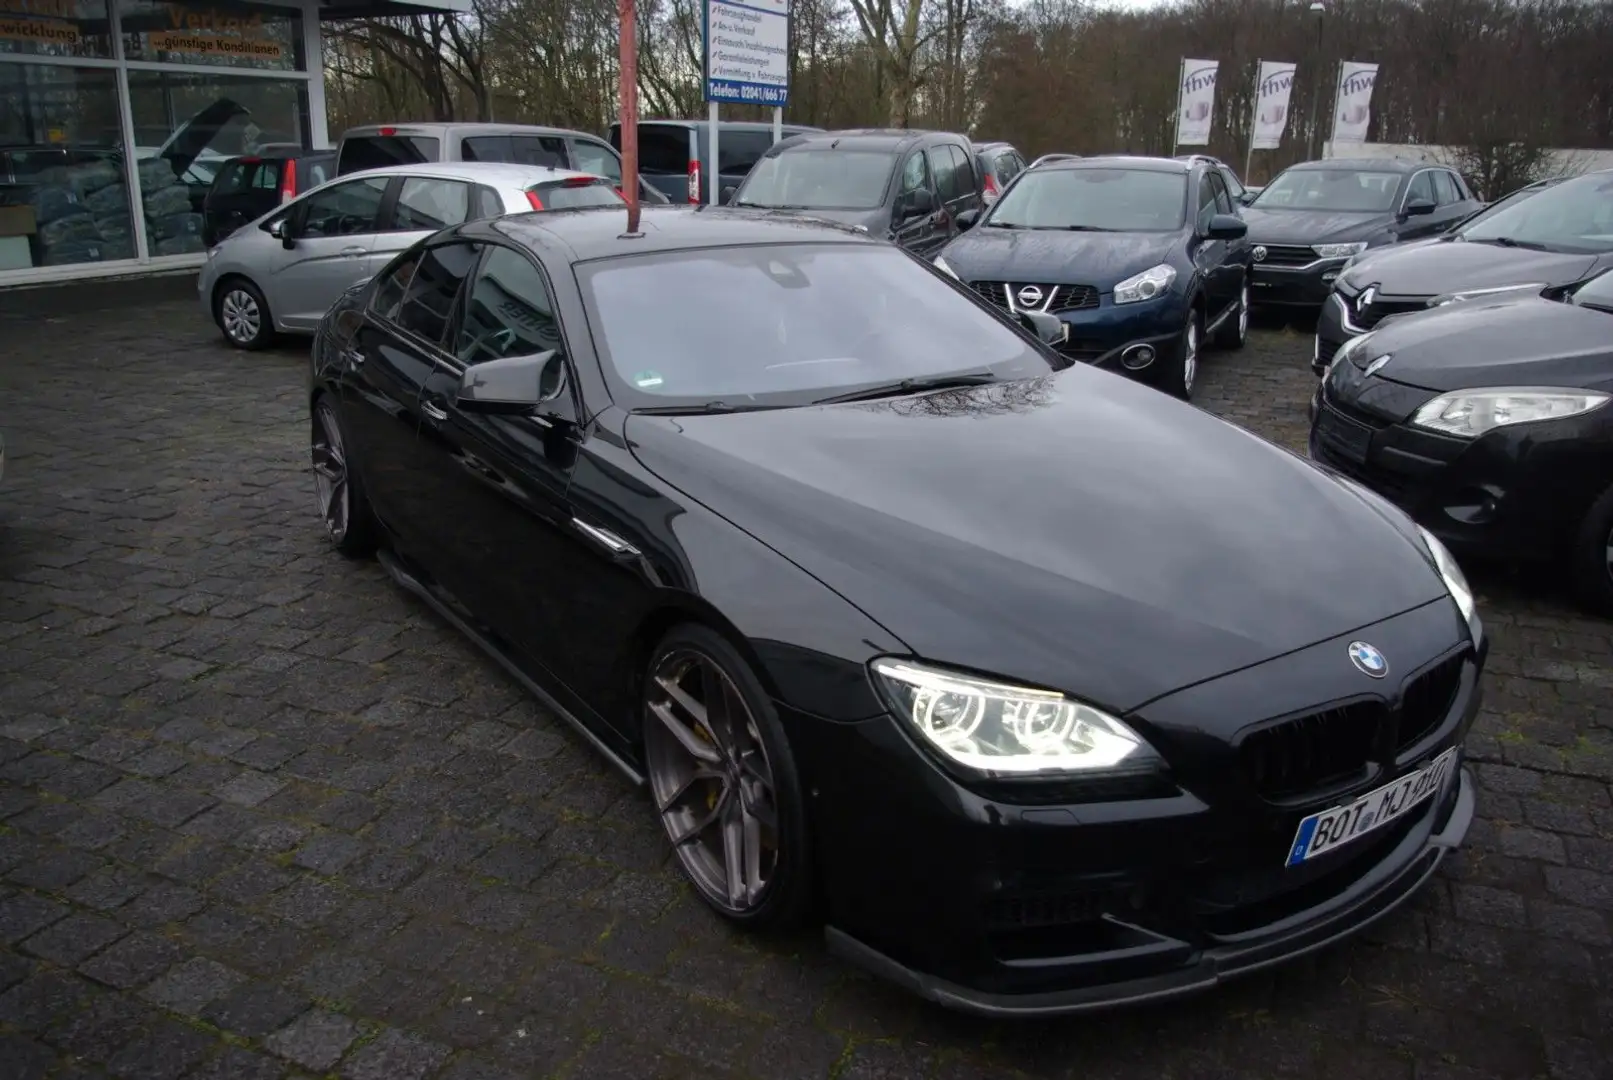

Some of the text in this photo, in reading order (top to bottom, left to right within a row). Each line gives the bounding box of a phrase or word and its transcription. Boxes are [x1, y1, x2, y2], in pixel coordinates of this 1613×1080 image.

[216, 39, 280, 56] Konditionen
[709, 82, 788, 102] Telefon: 02041/666 77
[1311, 801, 1369, 850] BOT
